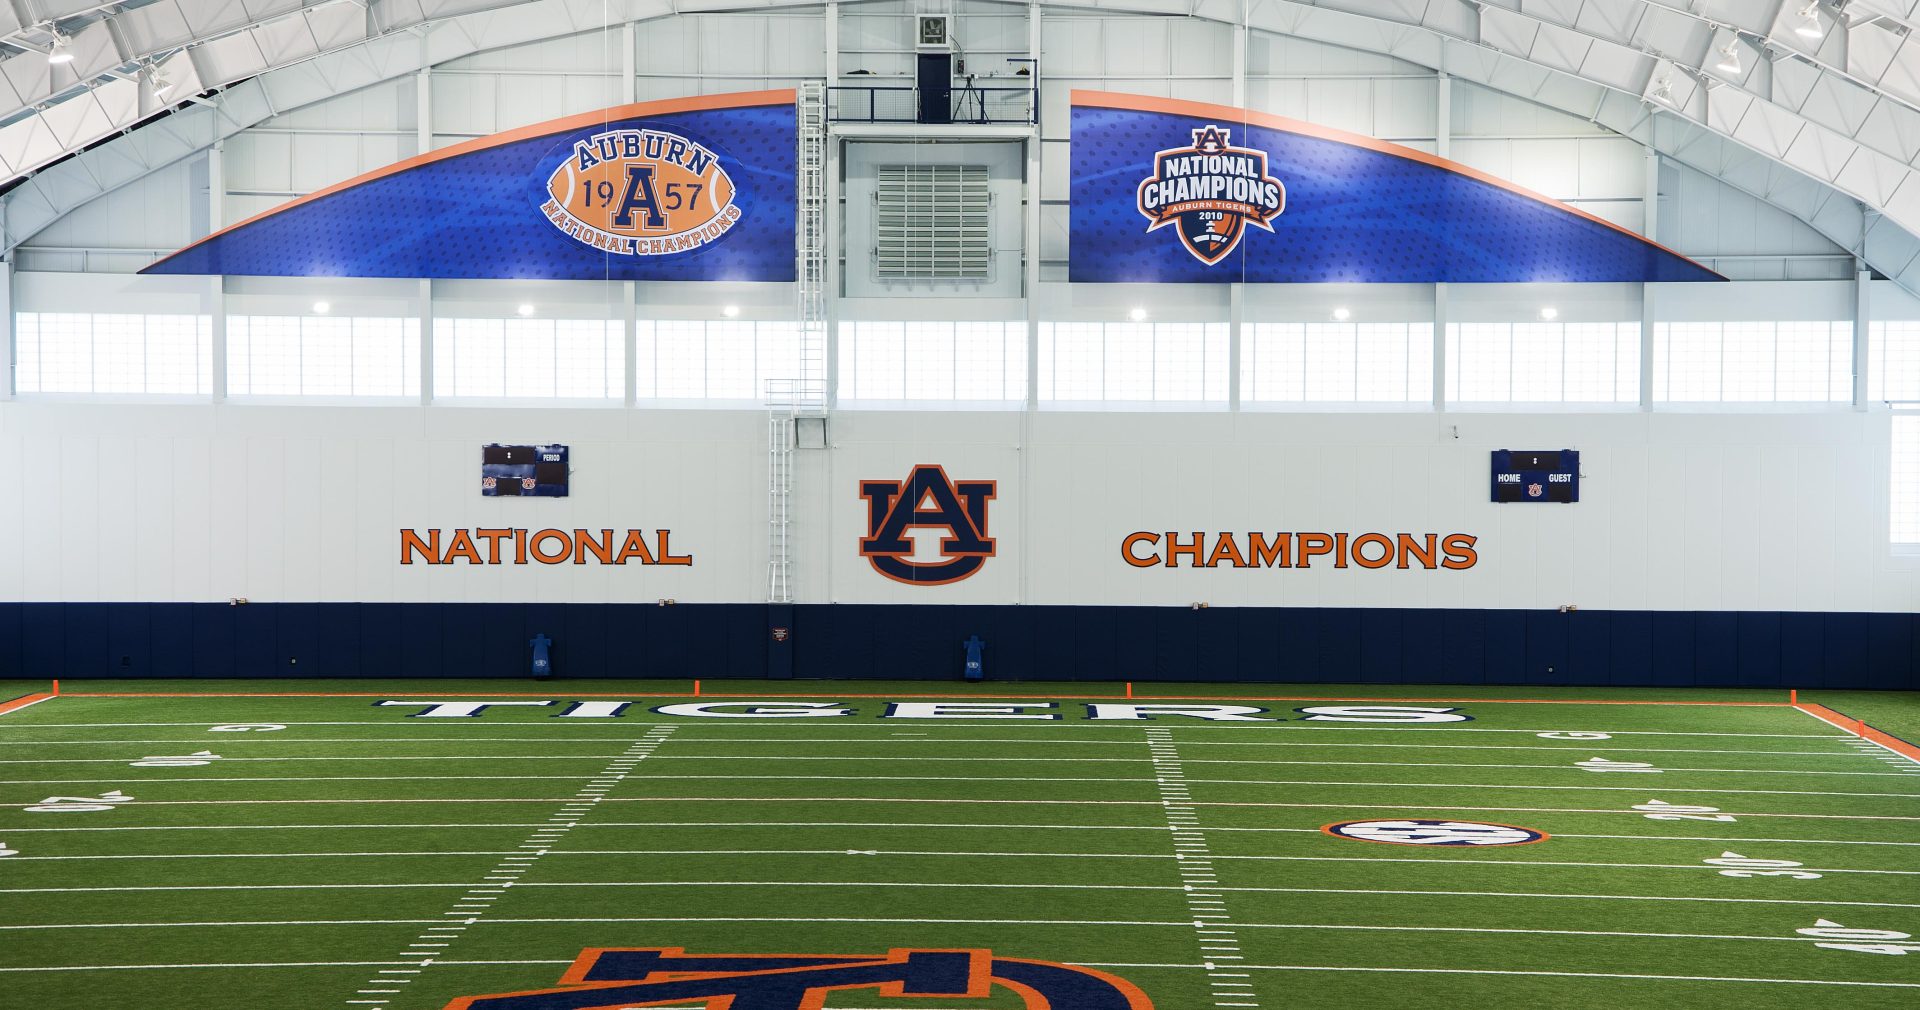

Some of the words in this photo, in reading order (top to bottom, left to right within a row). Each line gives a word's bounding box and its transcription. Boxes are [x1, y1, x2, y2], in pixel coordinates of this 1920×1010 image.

[576, 132, 715, 177] AUBURN
[1165, 155, 1259, 179] NATIONAL
[1144, 175, 1279, 209] CHAMPIONS
[1172, 201, 1213, 213] AUBURN
[1215, 201, 1252, 213] TIGERS
[1198, 211, 1223, 221] 2010
[543, 200, 634, 254] NATIONAL
[636, 205, 741, 254] CHAMPIONS
[542, 453, 561, 462] PERIOD
[1497, 473, 1521, 483] HOME
[1548, 473, 1572, 483] GUEST
[400, 528, 692, 567] NATIONAL
[1121, 531, 1478, 571] CHAMPIONS
[371, 700, 1475, 723] TIGERS
[129, 754, 222, 767] 10
[1573, 761, 1664, 773] 10
[23, 795, 134, 812] 20
[1630, 804, 1738, 822] 20
[1702, 857, 1823, 880] 30
[1795, 927, 1915, 955] 40
